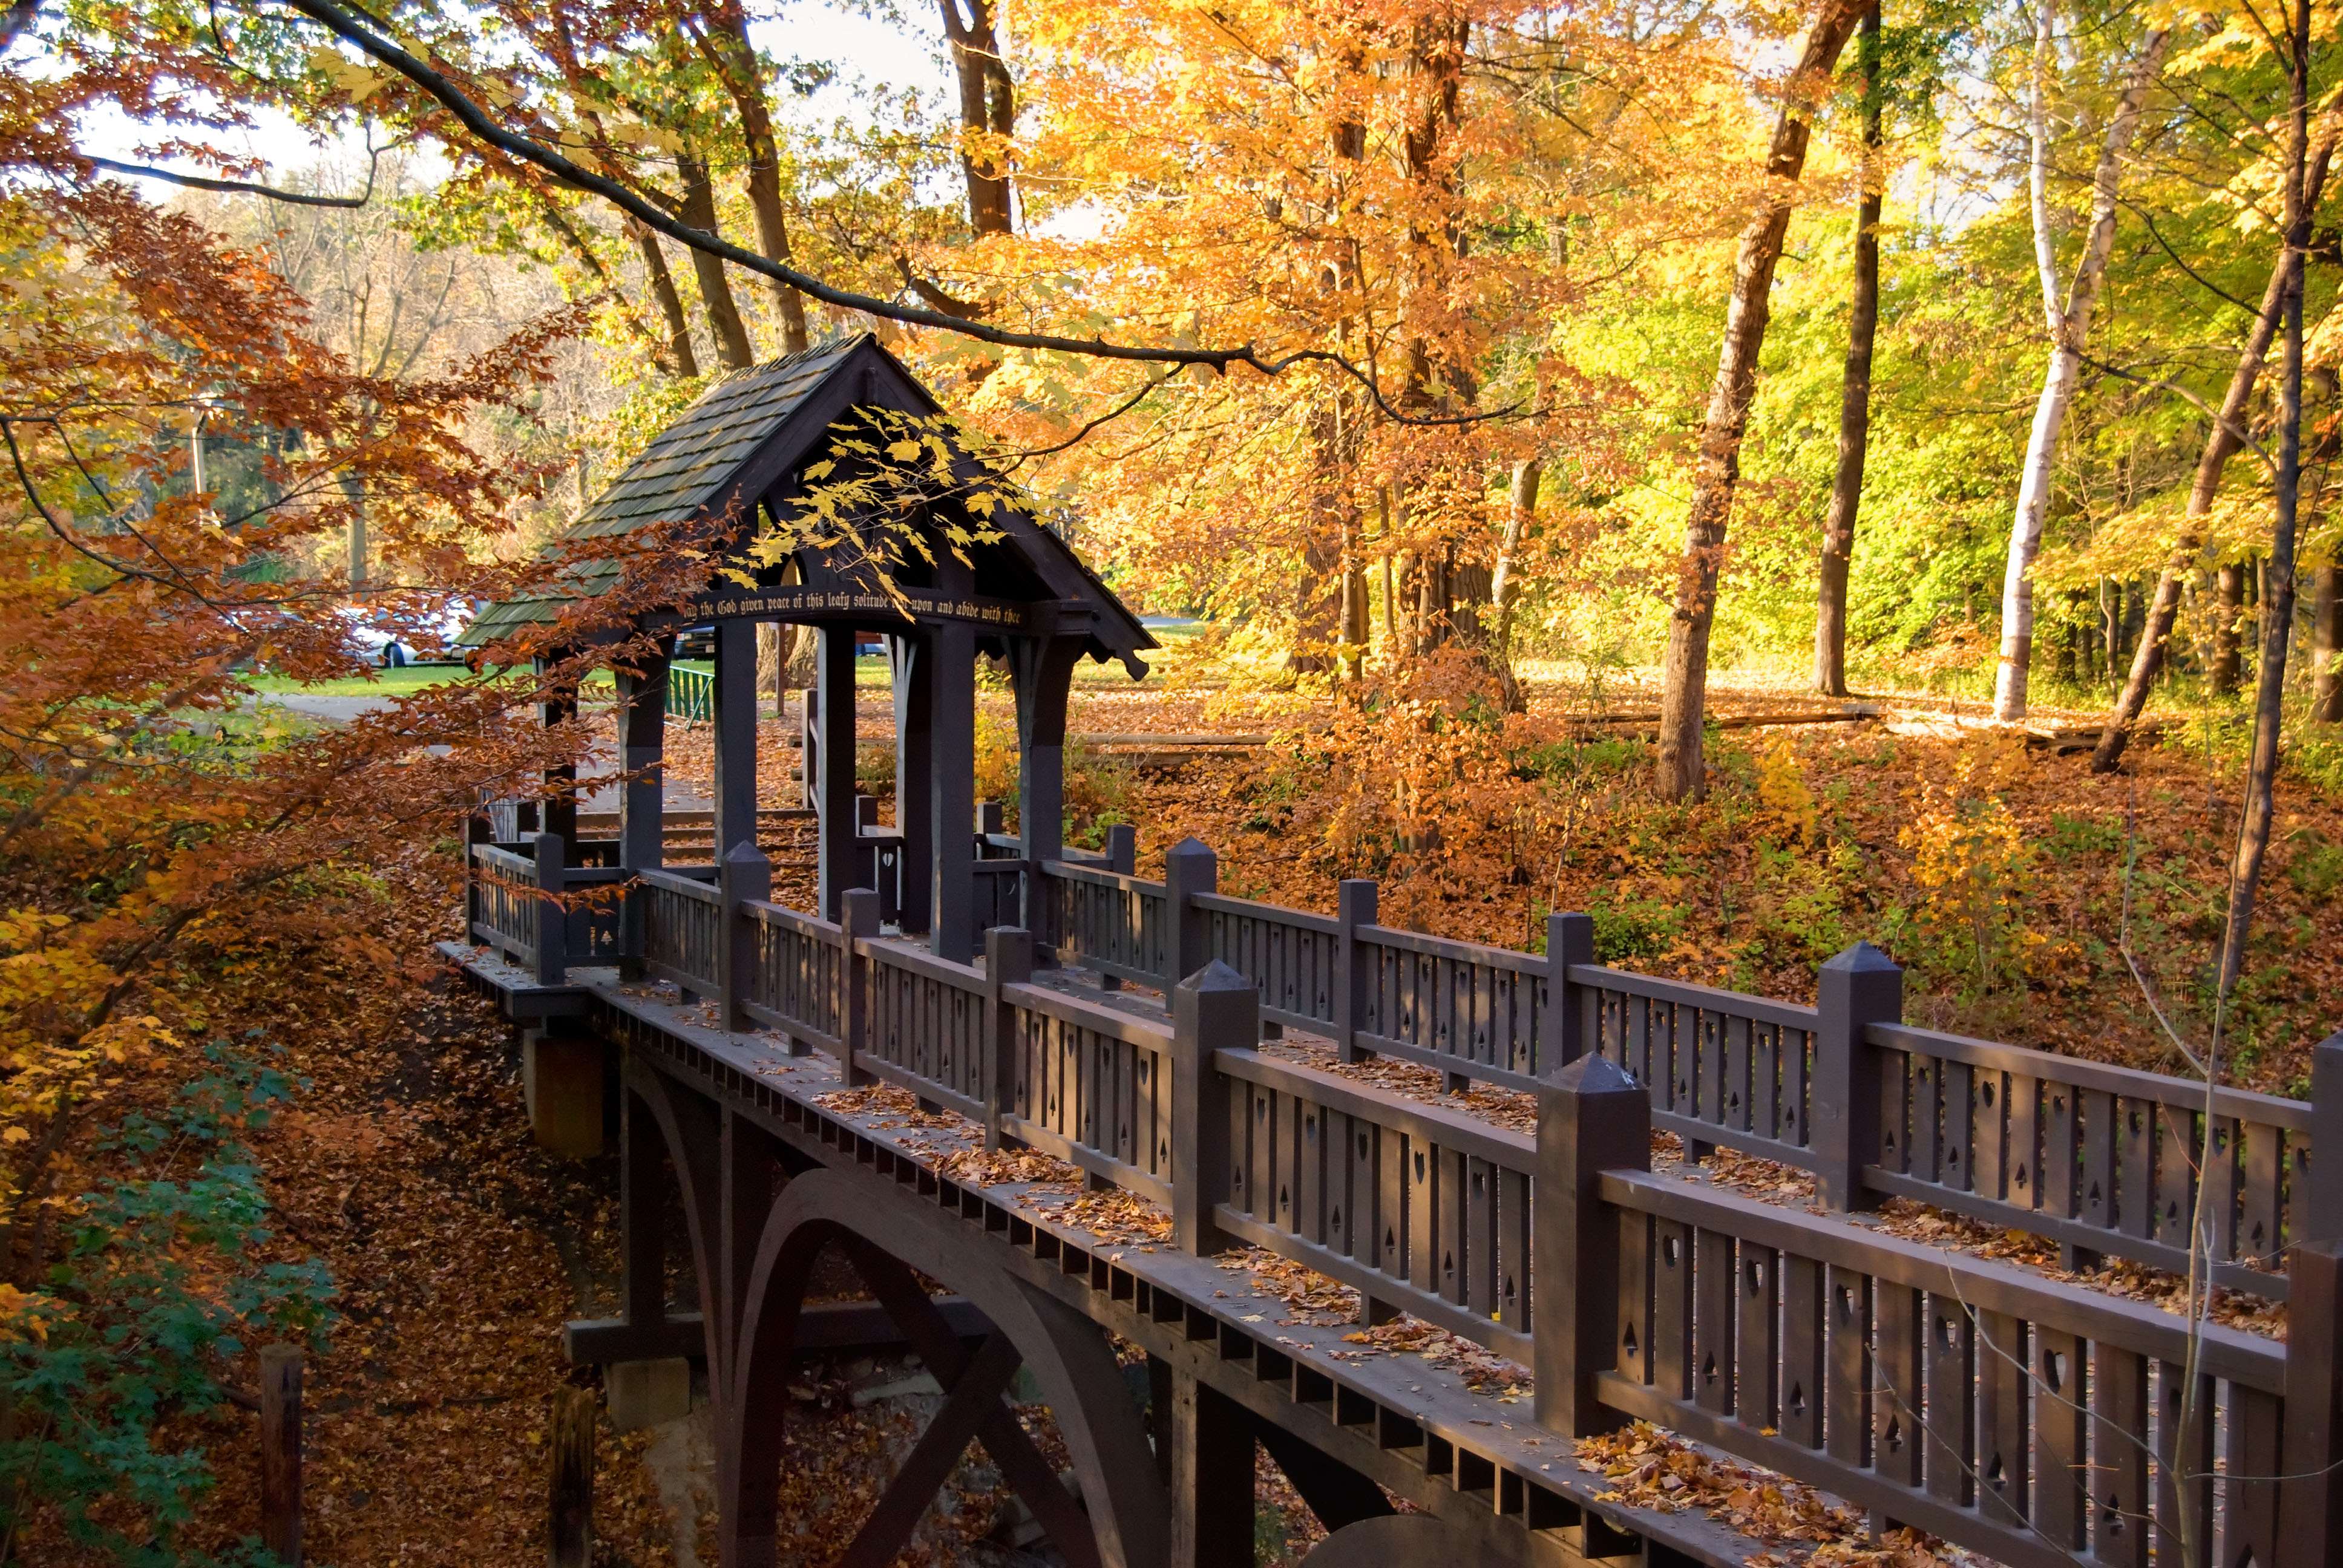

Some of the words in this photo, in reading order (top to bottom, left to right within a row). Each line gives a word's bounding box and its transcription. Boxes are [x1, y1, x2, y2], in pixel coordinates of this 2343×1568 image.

[700, 601, 714, 618] the
[718, 598, 737, 615] God
[740, 596, 764, 615] given
[767, 597, 790, 613] peace
[793, 593, 802, 609] of
[807, 592, 824, 610] this
[827, 591, 850, 610] leafy
[854, 592, 888, 608] solitude
[911, 599, 932, 613] upon
[937, 600, 953, 615] and
[956, 601, 978, 618] abide
[981, 606, 1001, 624] with
[1004, 609, 1021, 625] thee
